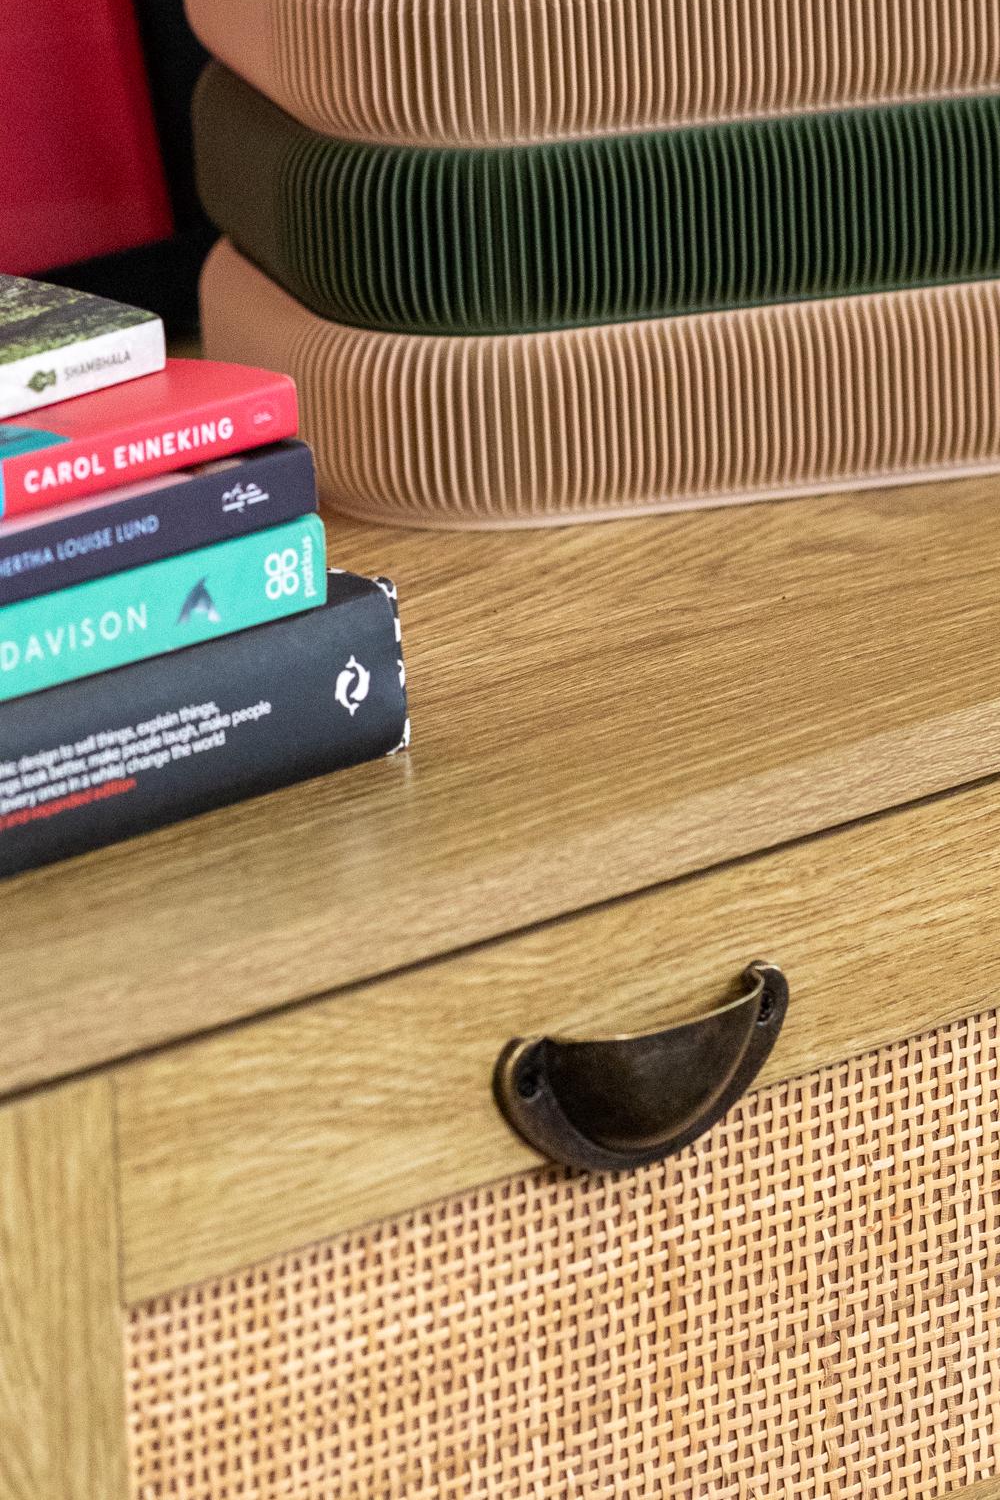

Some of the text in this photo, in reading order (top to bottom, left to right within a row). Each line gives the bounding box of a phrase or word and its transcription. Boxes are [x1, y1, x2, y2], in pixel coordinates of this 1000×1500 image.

[23, 416, 235, 494] CAROL ENNEKING
[0, 514, 160, 577] ERTHA LOUISE LUND
[0, 602, 148, 671] DAVISON
[19, 749, 60, 774] design
[60, 744, 74, 761] to
[74, 734, 97, 757] sell
[136, 711, 180, 737] explain
[87, 747, 122, 768] make
[121, 733, 162, 761] people
[198, 713, 232, 735] make
[231, 700, 272, 728] people
[125, 749, 171, 775] change
[170, 742, 192, 761] the
[191, 729, 226, 754] world
